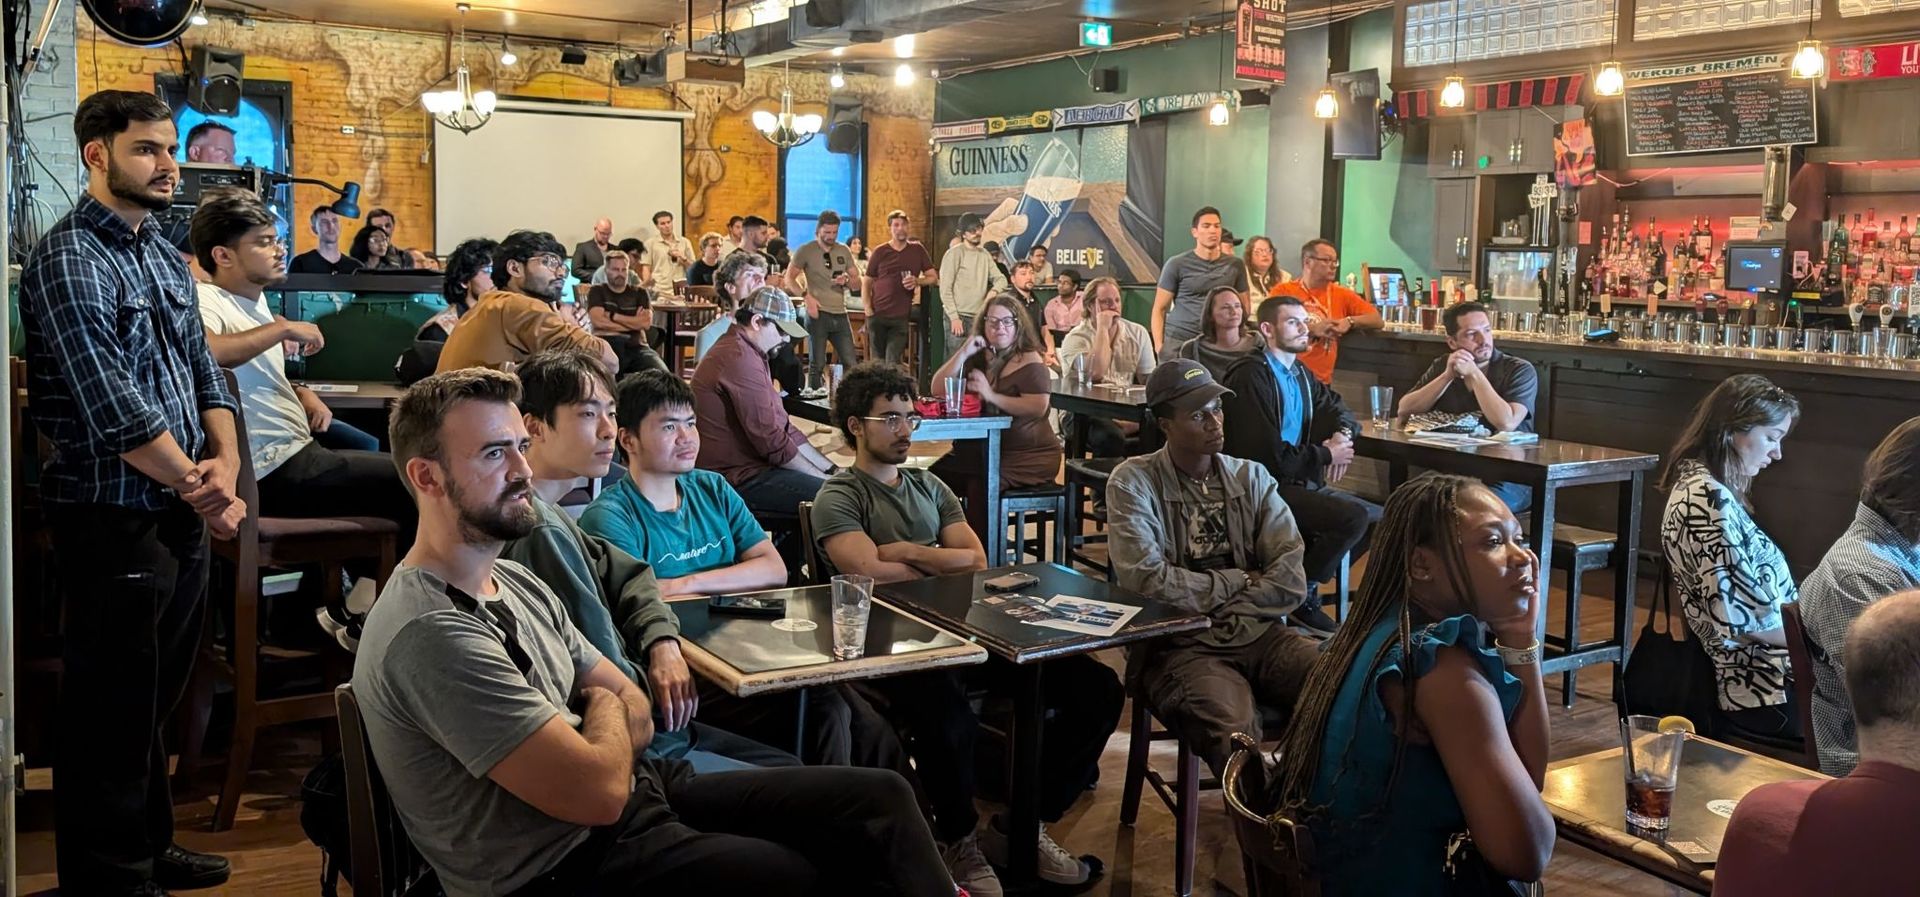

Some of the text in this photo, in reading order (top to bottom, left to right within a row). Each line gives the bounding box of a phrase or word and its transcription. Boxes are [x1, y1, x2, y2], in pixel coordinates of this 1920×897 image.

[1253, 0, 1286, 12] SHOT
[1626, 64, 1696, 79] WERDER
[1702, 55, 1778, 71] BREMEN
[1901, 64, 1919, 74] YOU
[1164, 92, 1210, 110] IRELAND
[949, 144, 1029, 176] GUINNESS
[1056, 247, 1104, 269] BELIEVE
